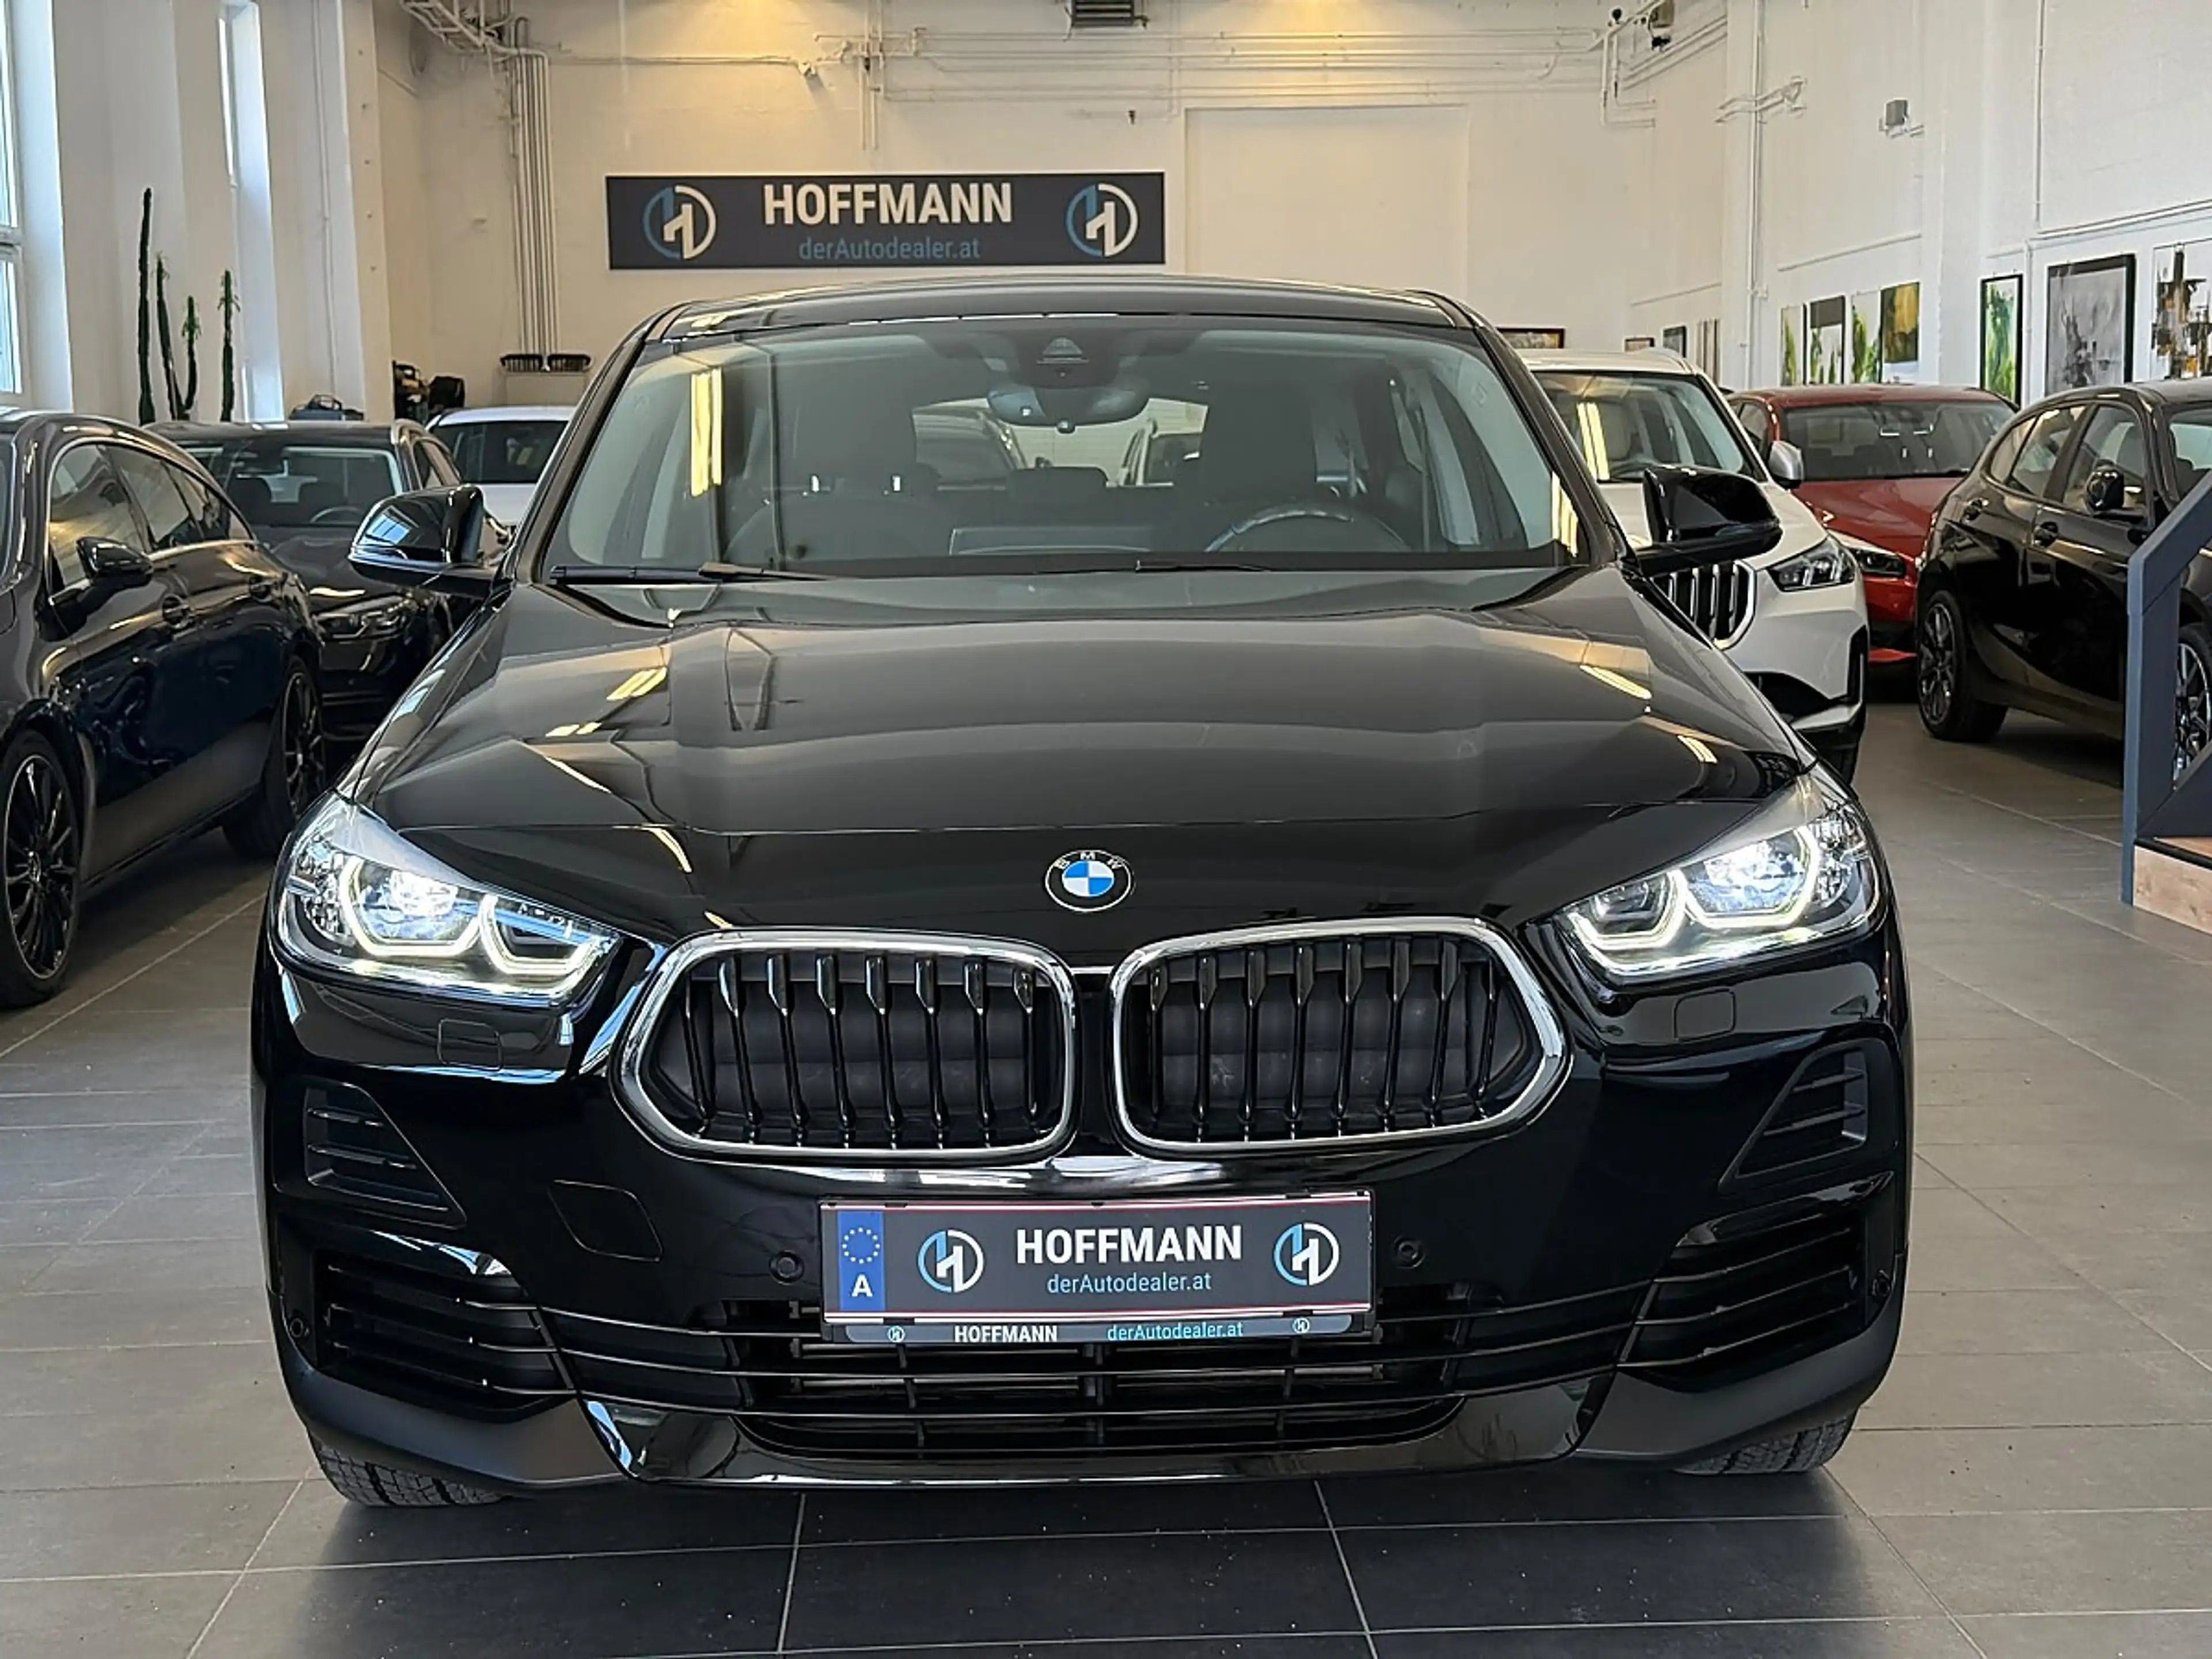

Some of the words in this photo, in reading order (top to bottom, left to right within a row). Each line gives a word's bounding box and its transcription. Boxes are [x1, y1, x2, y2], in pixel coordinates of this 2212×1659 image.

[763, 182, 1012, 225] HOFFMANN
[798, 236, 980, 260] derAutodealer.at
[1053, 850, 1124, 869] BMW
[1017, 1225, 1241, 1264] HOFFMANN
[851, 1274, 873, 1297] A
[1047, 1271, 1212, 1294] derAutodealer.at
[954, 1325, 1058, 1343] HOFFMANN
[1107, 1322, 1244, 1341] derAutodealer.at
